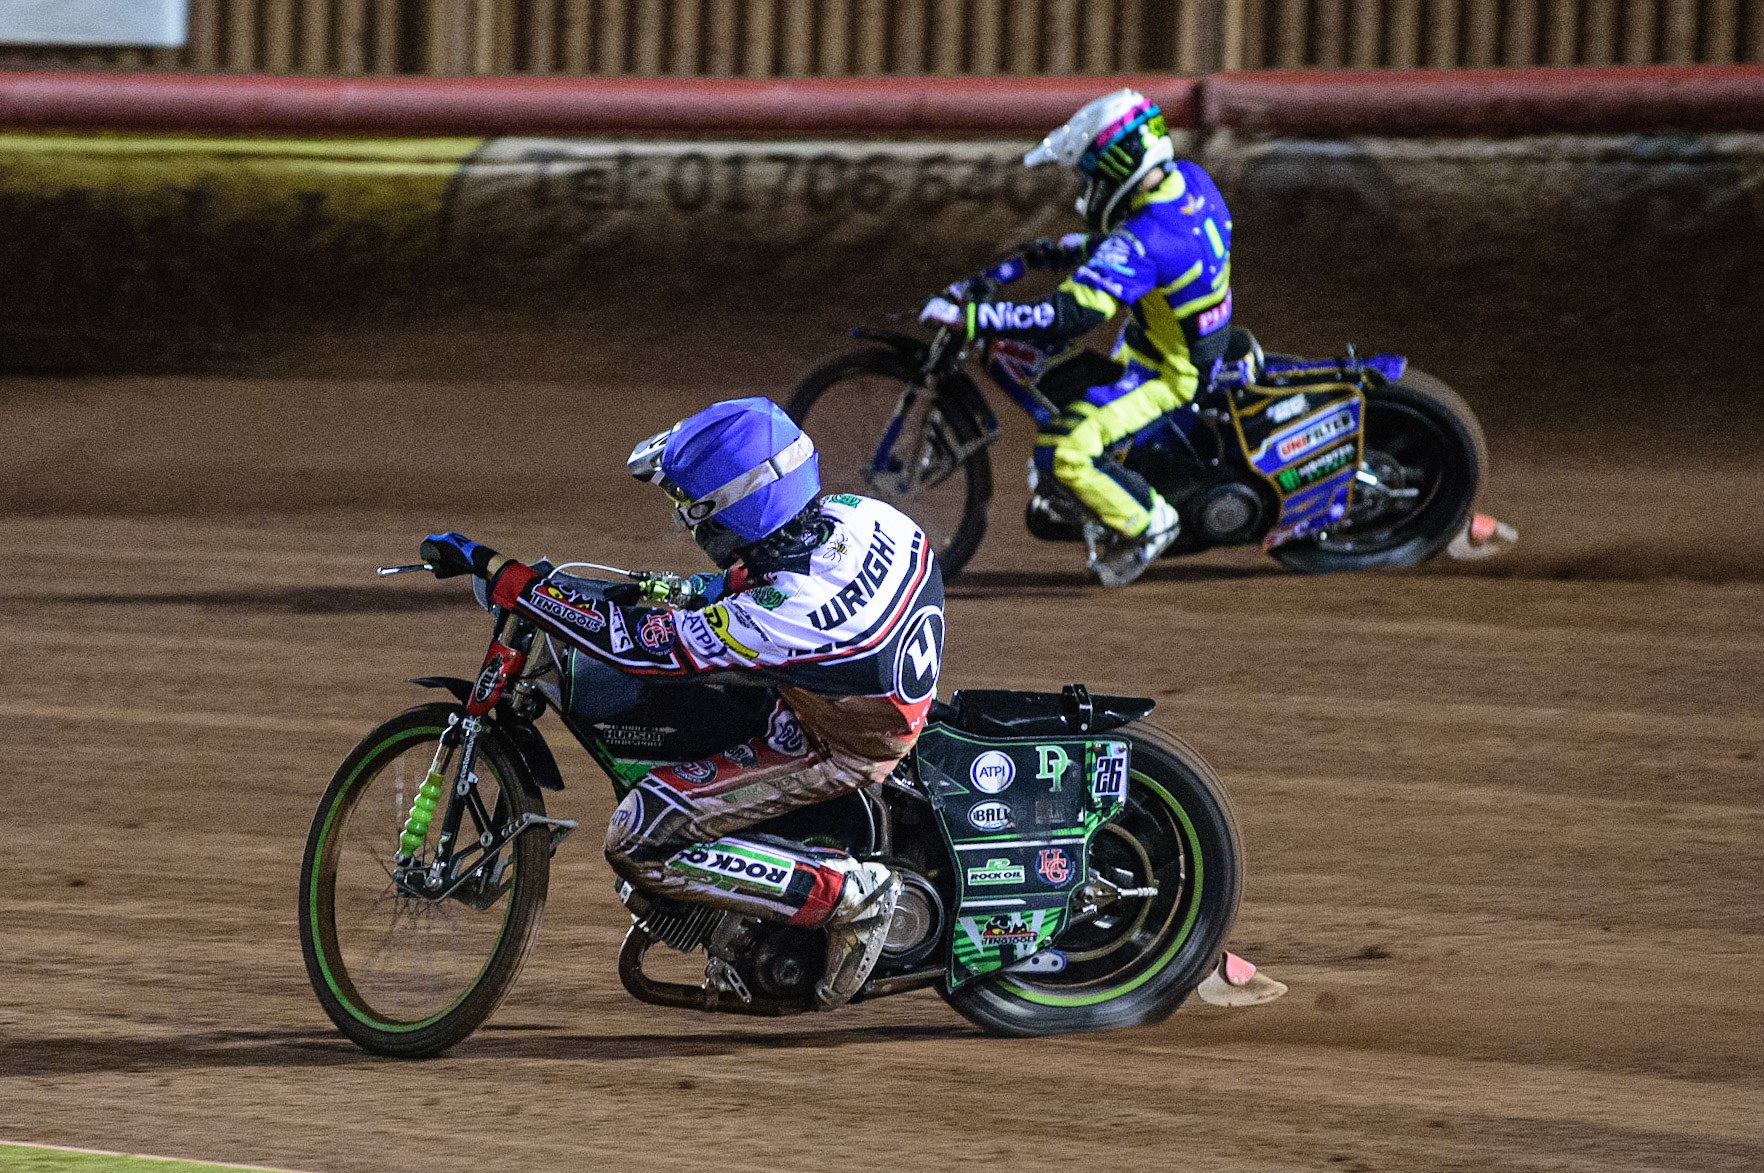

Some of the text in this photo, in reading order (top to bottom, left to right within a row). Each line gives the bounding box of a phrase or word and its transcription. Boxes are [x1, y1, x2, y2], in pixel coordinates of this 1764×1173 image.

[806, 520, 895, 631] WRIGHT
[686, 615, 717, 650] ATPI
[979, 764, 1006, 778] ATPI
[1095, 757, 1124, 795] 26
[709, 854, 788, 885] ROCK
[970, 870, 1022, 880] ROCK OIL
